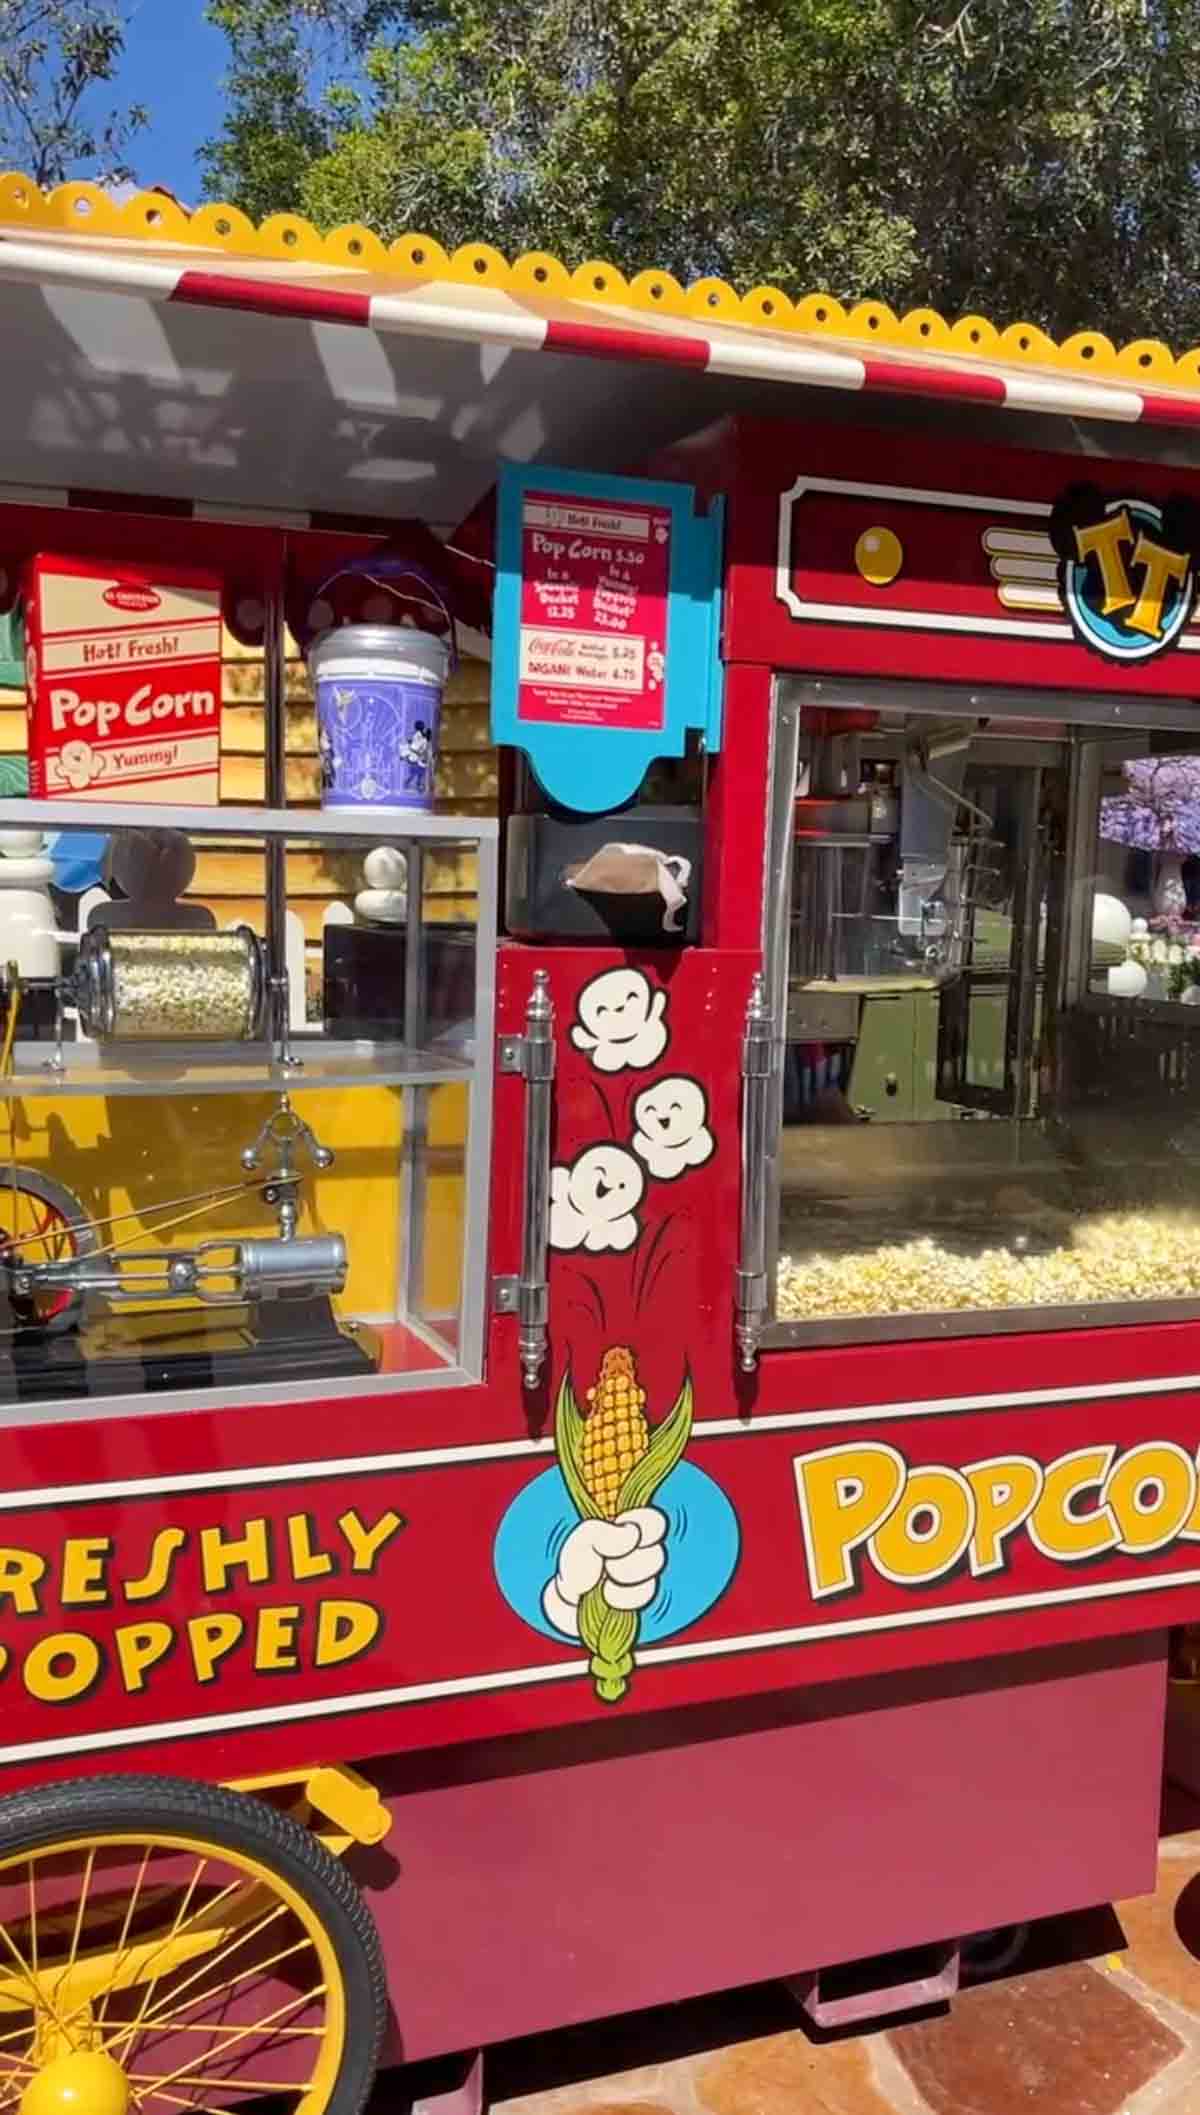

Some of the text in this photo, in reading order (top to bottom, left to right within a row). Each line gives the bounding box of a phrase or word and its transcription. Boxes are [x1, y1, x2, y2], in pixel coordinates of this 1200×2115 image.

[532, 531, 566, 561] Pop
[567, 538, 613, 561] Corn
[83, 637, 179, 663] Hot! Fresh!
[50, 683, 215, 737] Pop Corn
[113, 745, 179, 770] Yummy!
[793, 1441, 1200, 1600] POPCO
[0, 1600, 380, 1701] OPPED
